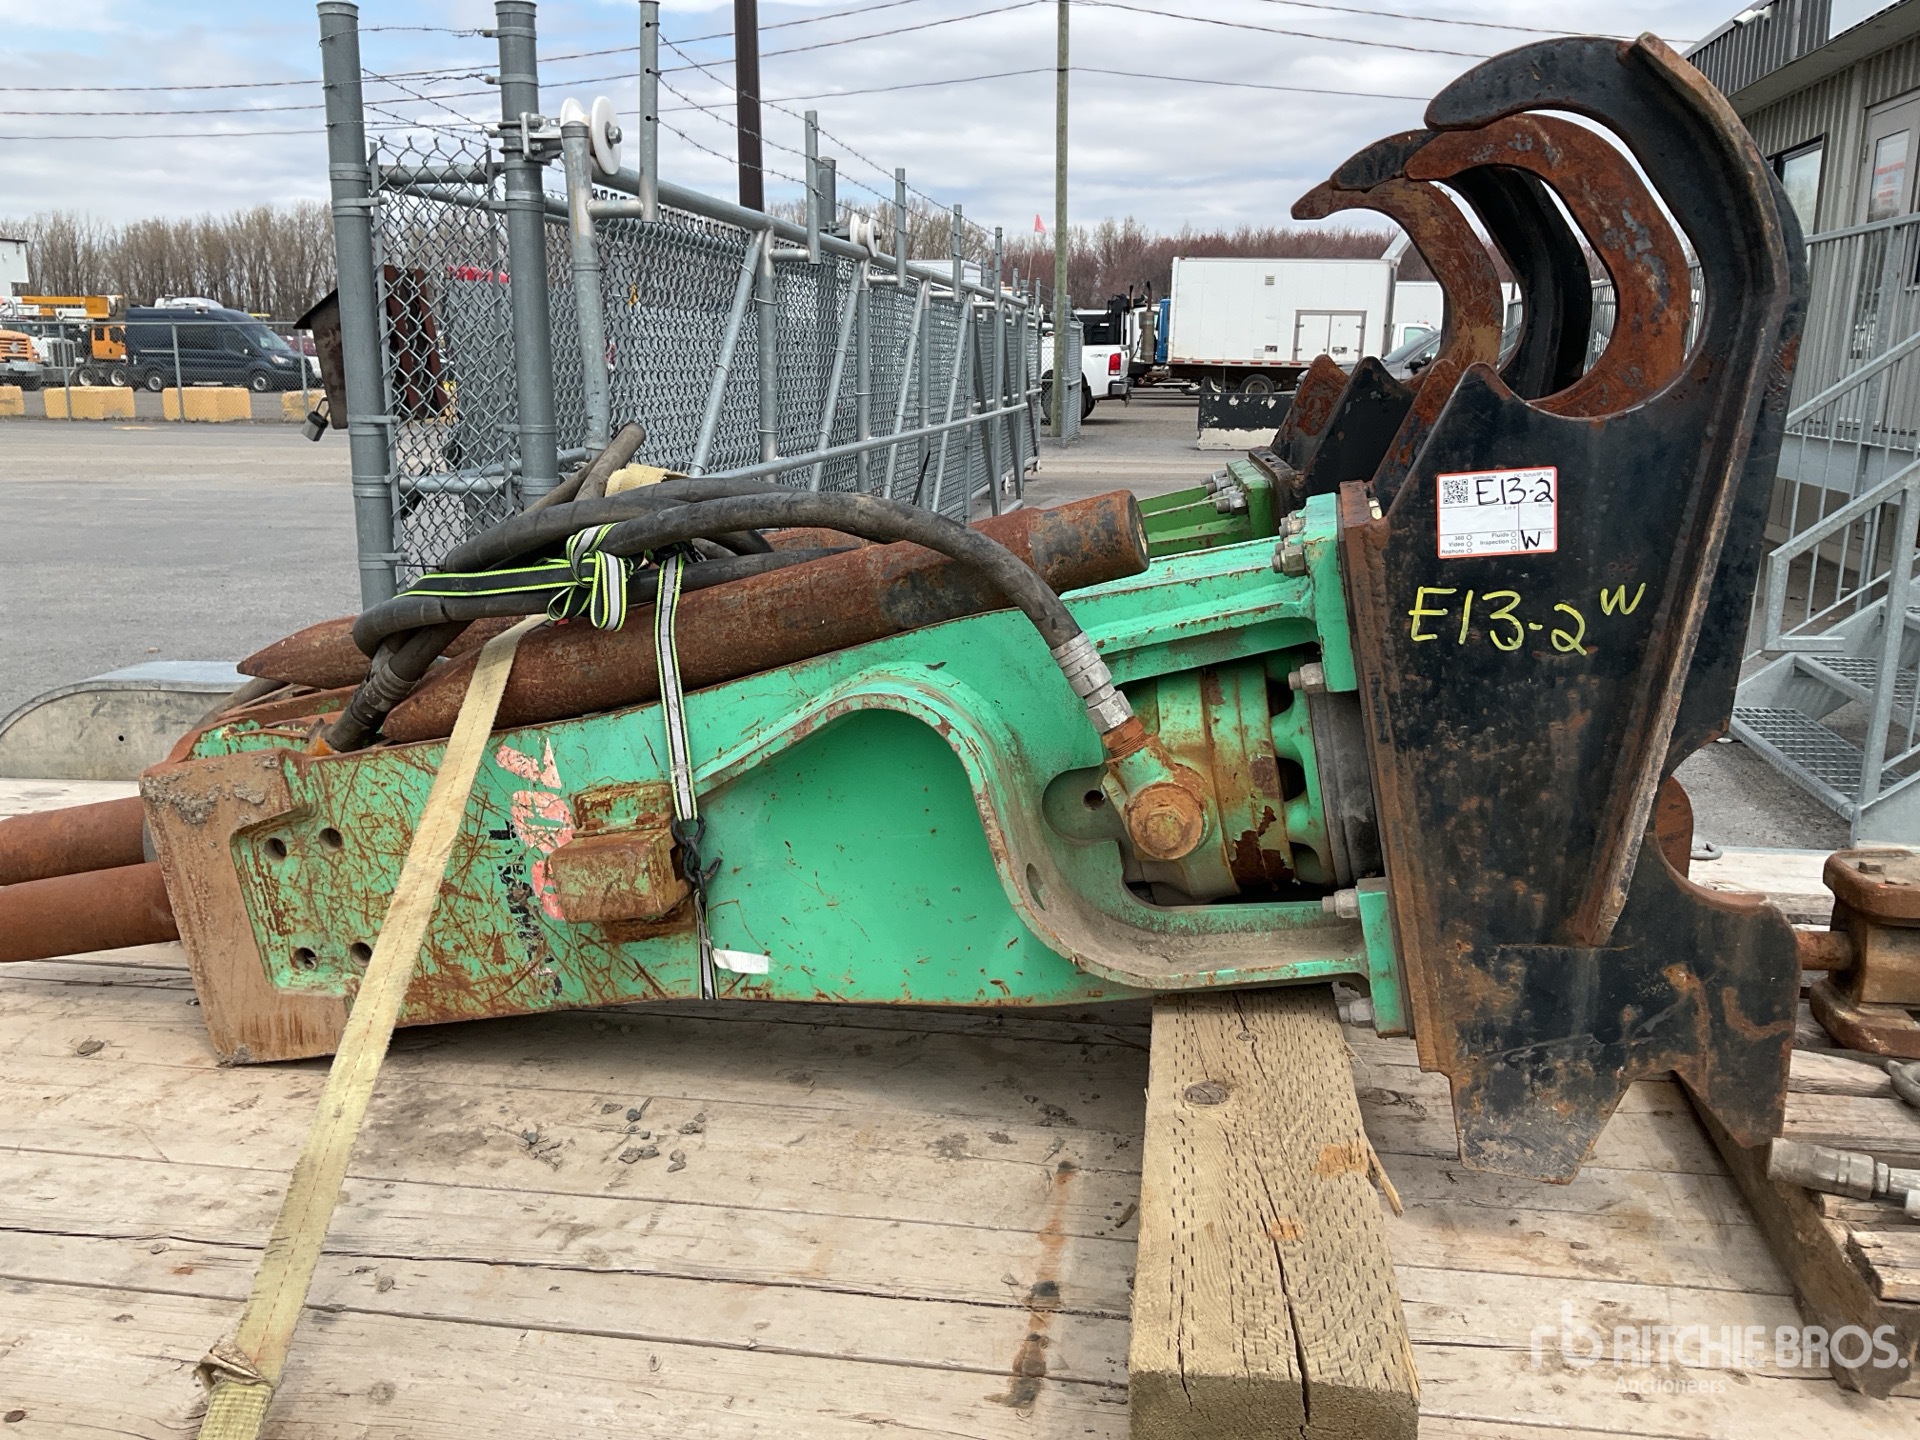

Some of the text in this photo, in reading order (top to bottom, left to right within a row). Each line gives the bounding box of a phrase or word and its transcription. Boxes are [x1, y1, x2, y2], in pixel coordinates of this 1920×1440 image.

[1476, 477, 1554, 505] E13-2
[1521, 530, 1540, 549] W
[1408, 582, 1647, 656] E13-2 W
